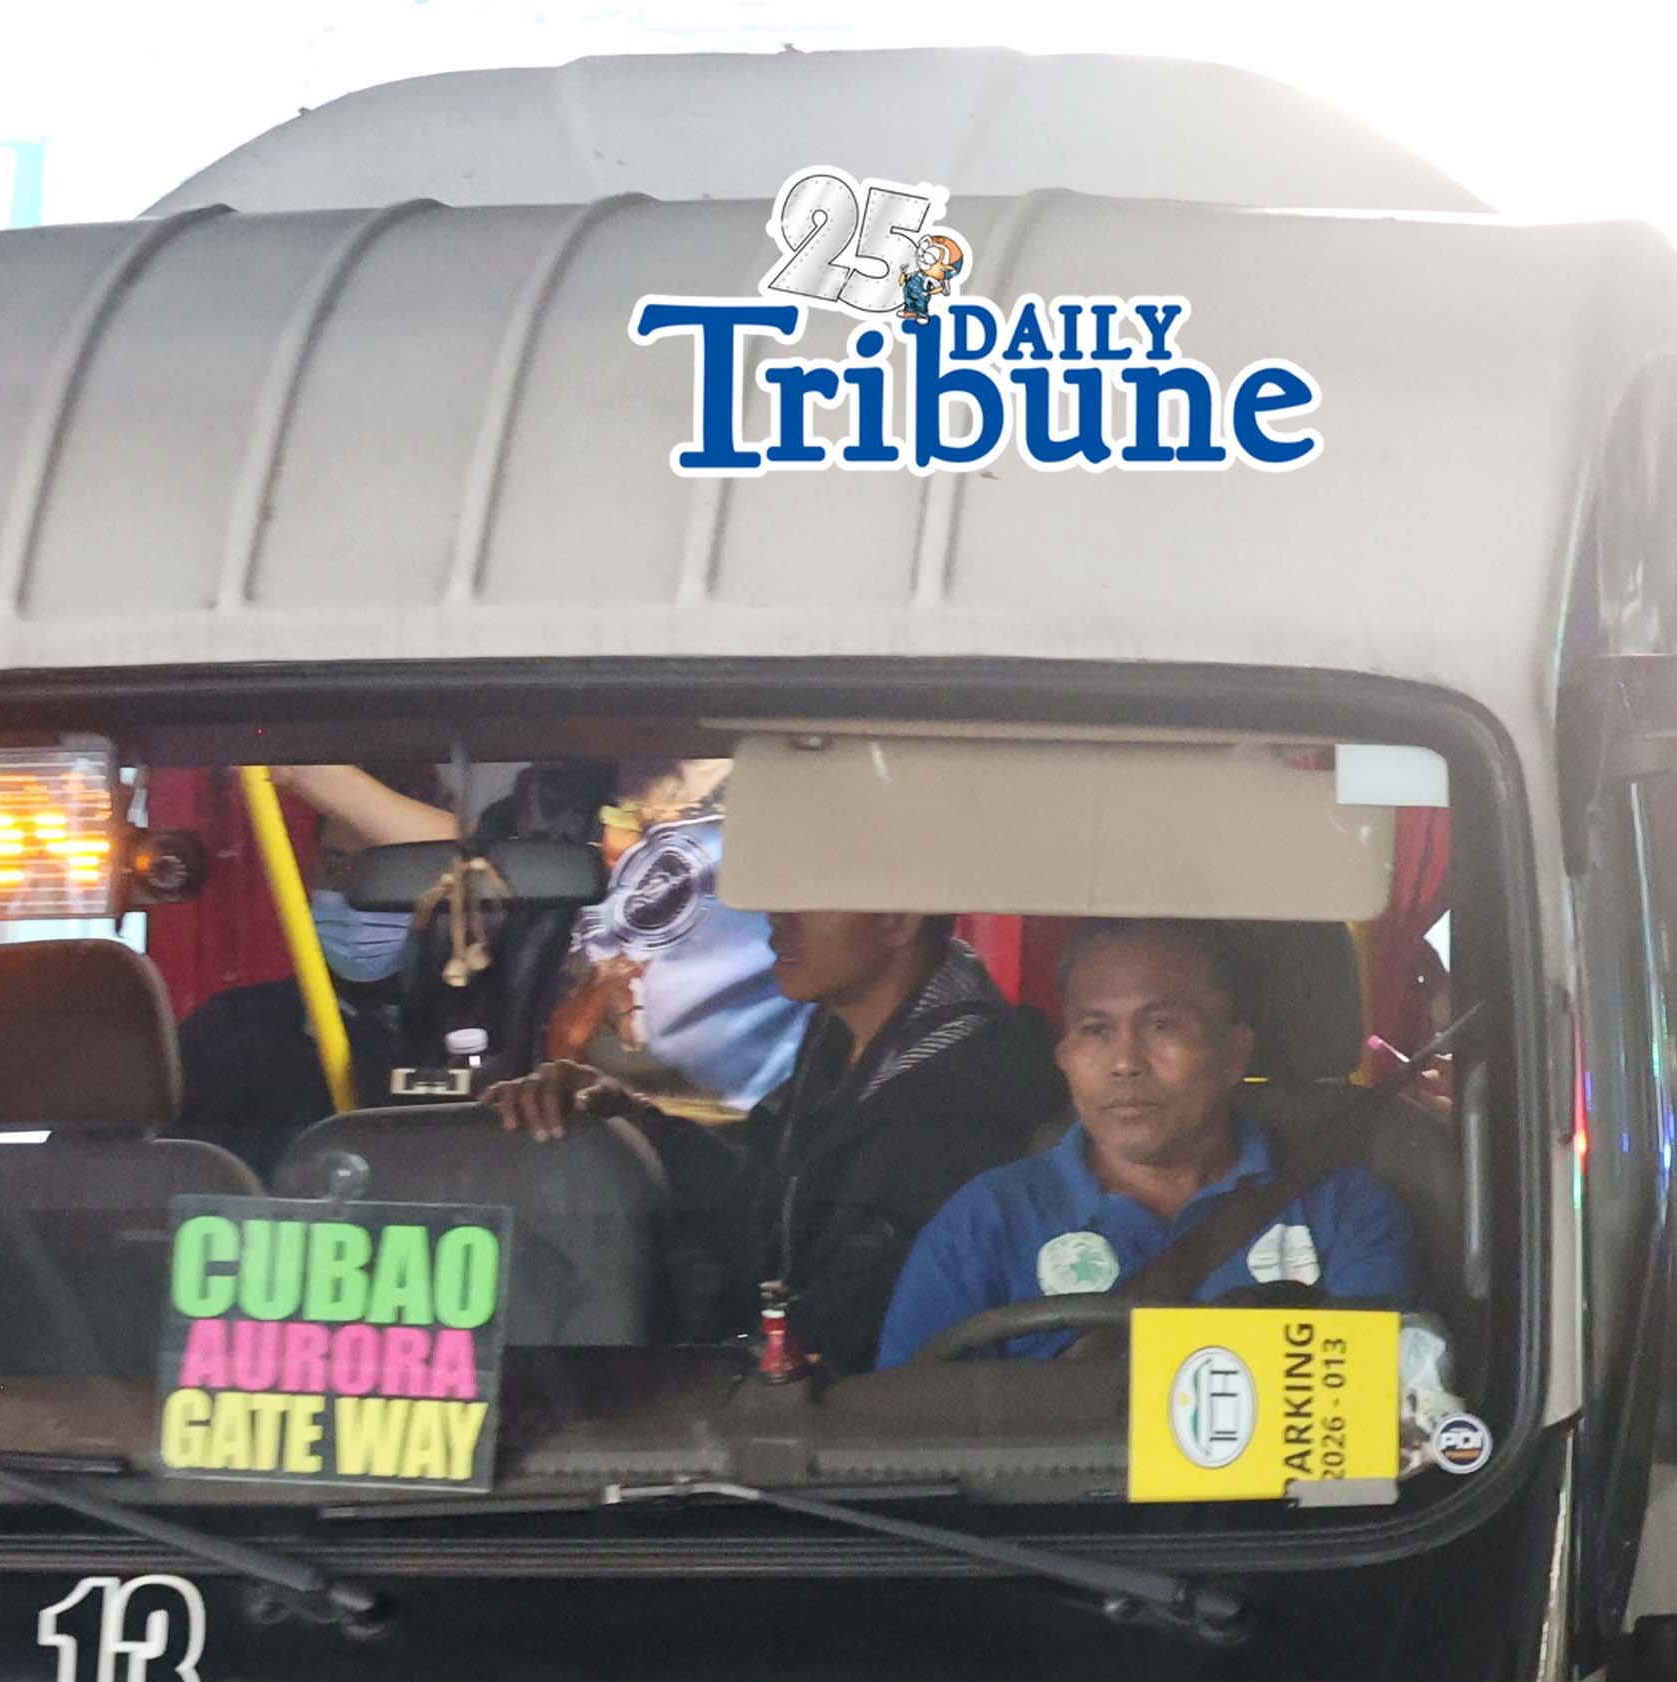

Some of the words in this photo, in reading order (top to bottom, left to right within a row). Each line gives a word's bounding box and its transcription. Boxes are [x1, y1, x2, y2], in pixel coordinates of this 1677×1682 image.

[171, 1214, 499, 1330] CUBAO
[177, 1317, 479, 1400] AURORA
[1321, 1337, 1347, 1388] 013
[160, 1387, 327, 1473] GATE
[334, 1396, 490, 1481] WAY
[1321, 1414, 1346, 1479] 2026
